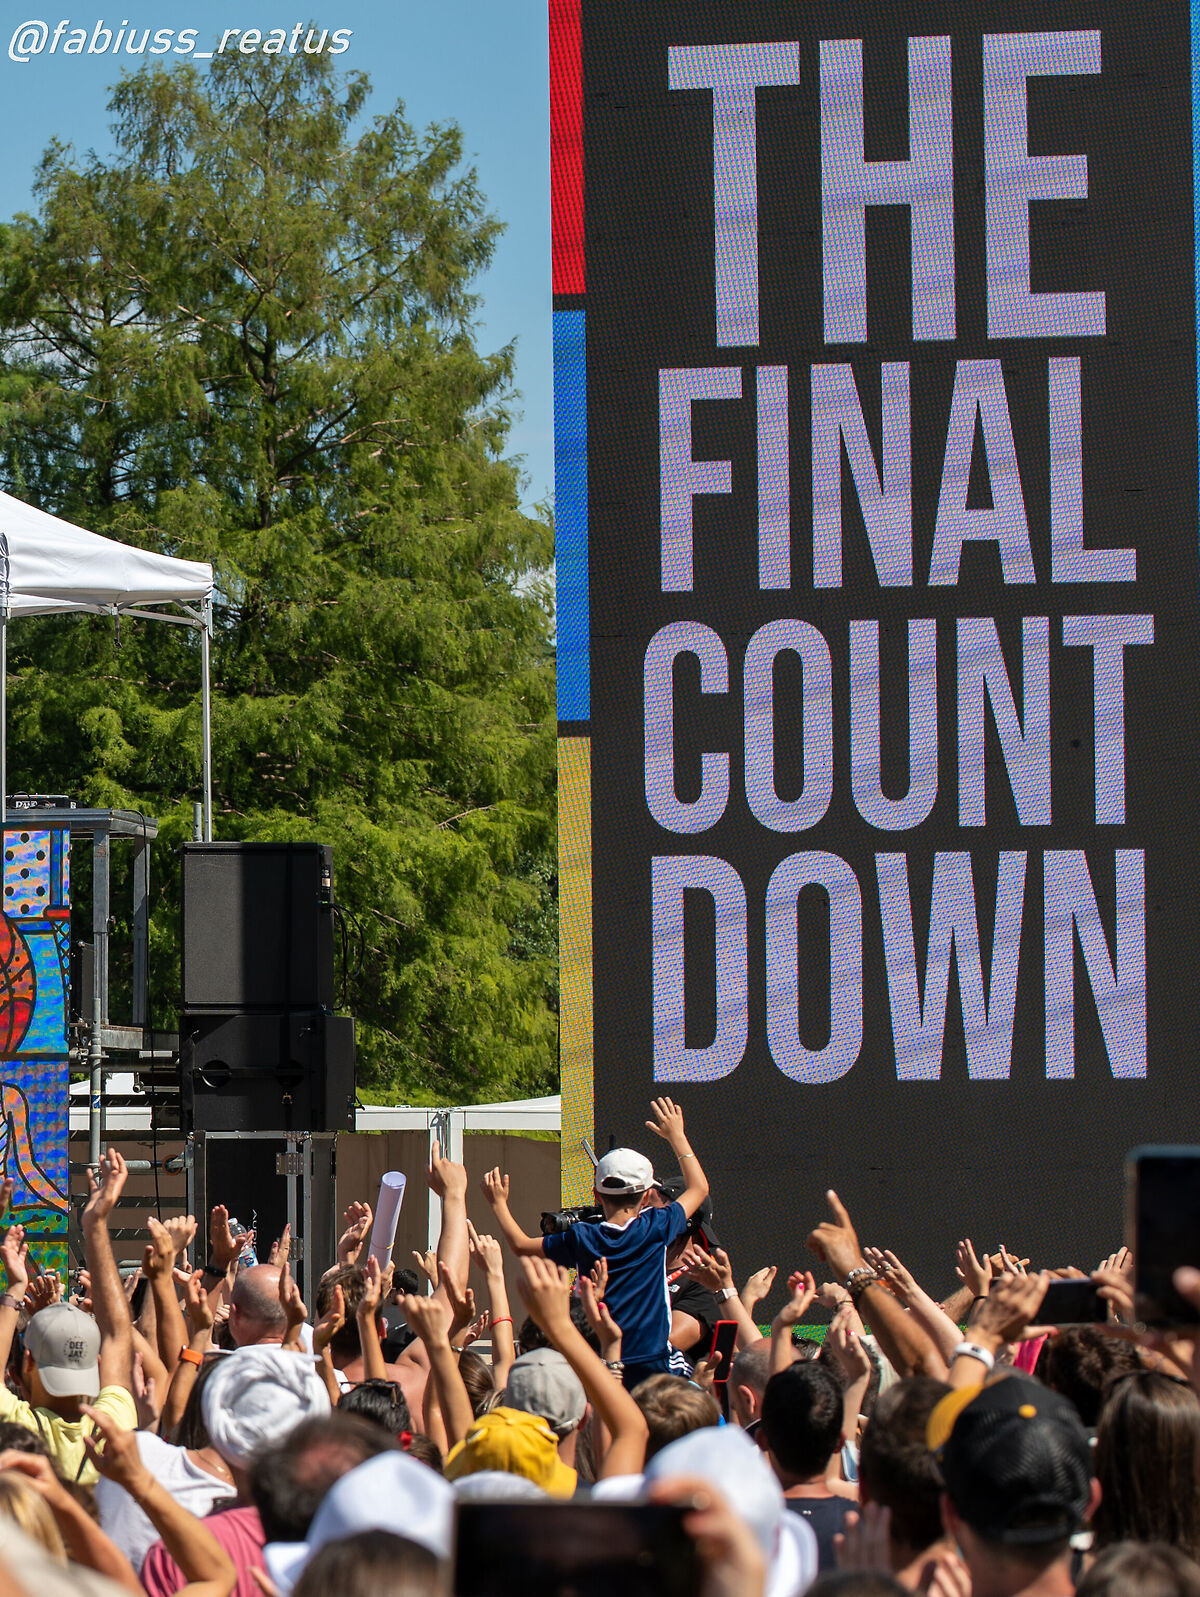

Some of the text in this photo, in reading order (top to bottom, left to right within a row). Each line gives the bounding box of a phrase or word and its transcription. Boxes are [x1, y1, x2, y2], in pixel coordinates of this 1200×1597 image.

[668, 29, 1107, 347] THE
[659, 356, 1138, 592] FINAL
[643, 614, 1155, 834] COUNT
[651, 848, 1149, 1085] DOWN
[69, 1341, 84, 1350] DEE
